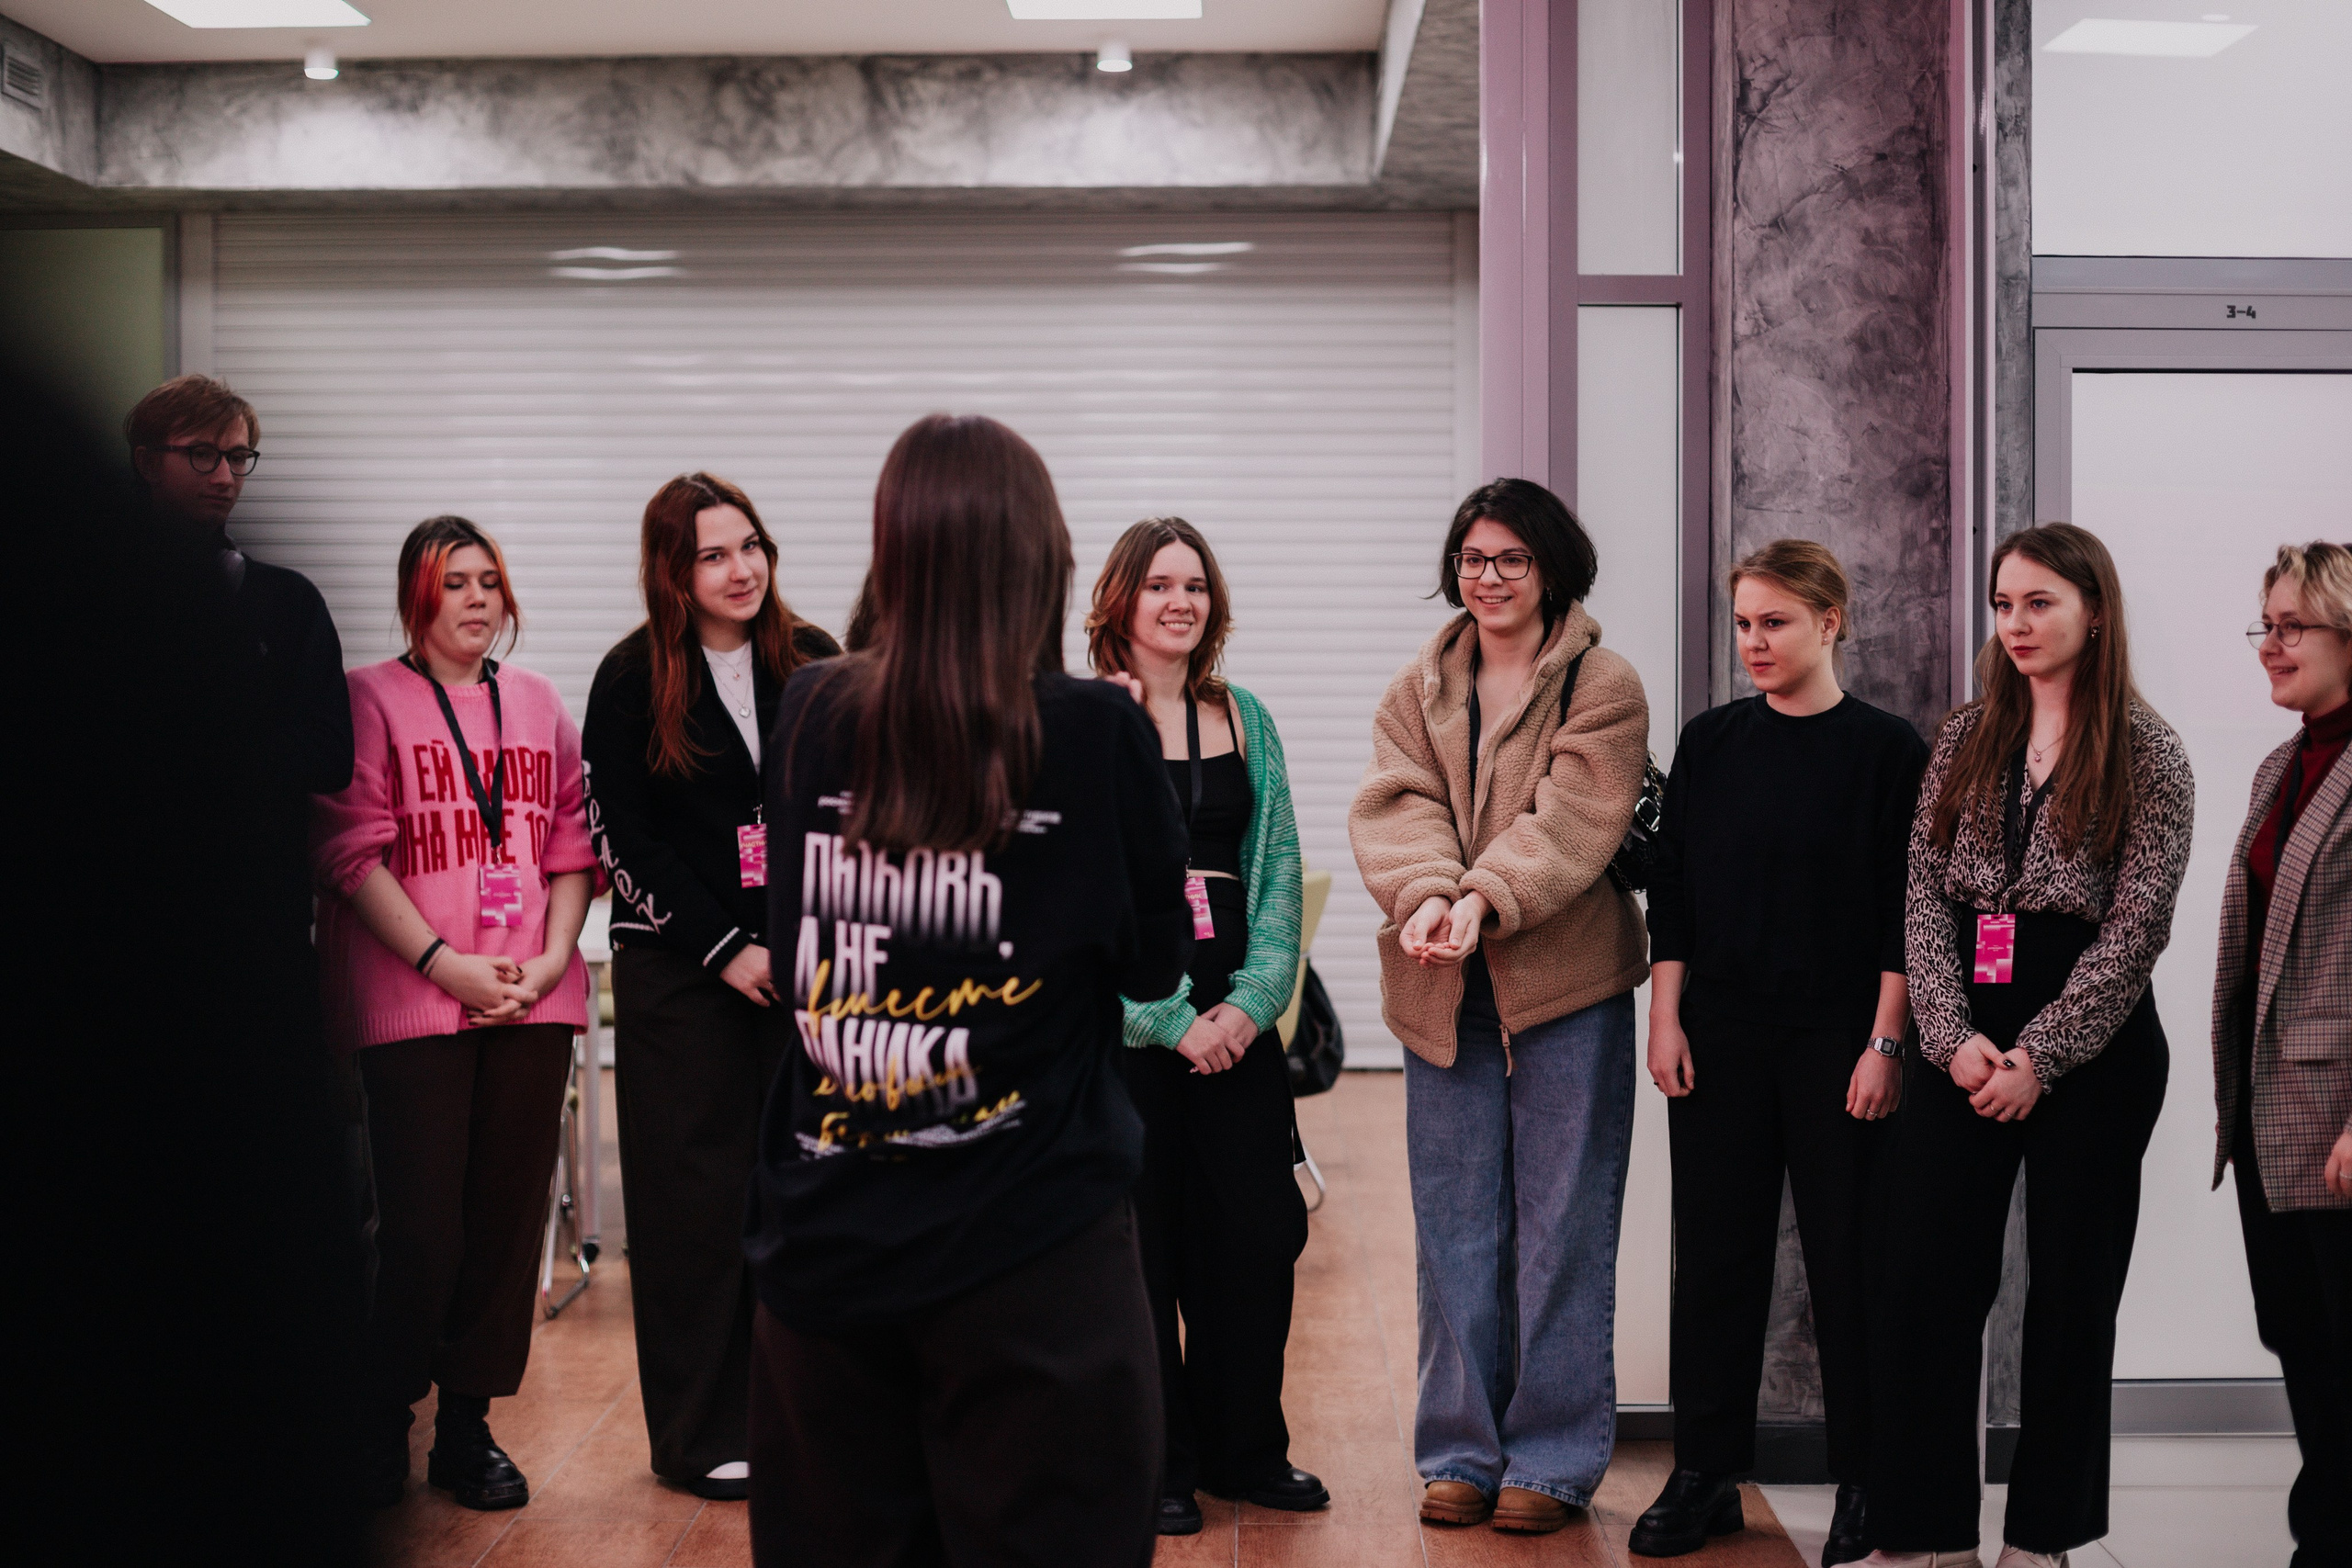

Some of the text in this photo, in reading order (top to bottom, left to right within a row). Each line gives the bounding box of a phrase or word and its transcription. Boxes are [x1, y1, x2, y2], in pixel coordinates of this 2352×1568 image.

[2227, 305, 2256, 319] 3-4
[413, 739, 458, 803] ЕЙ
[831, 919, 892, 1006] НЕ
